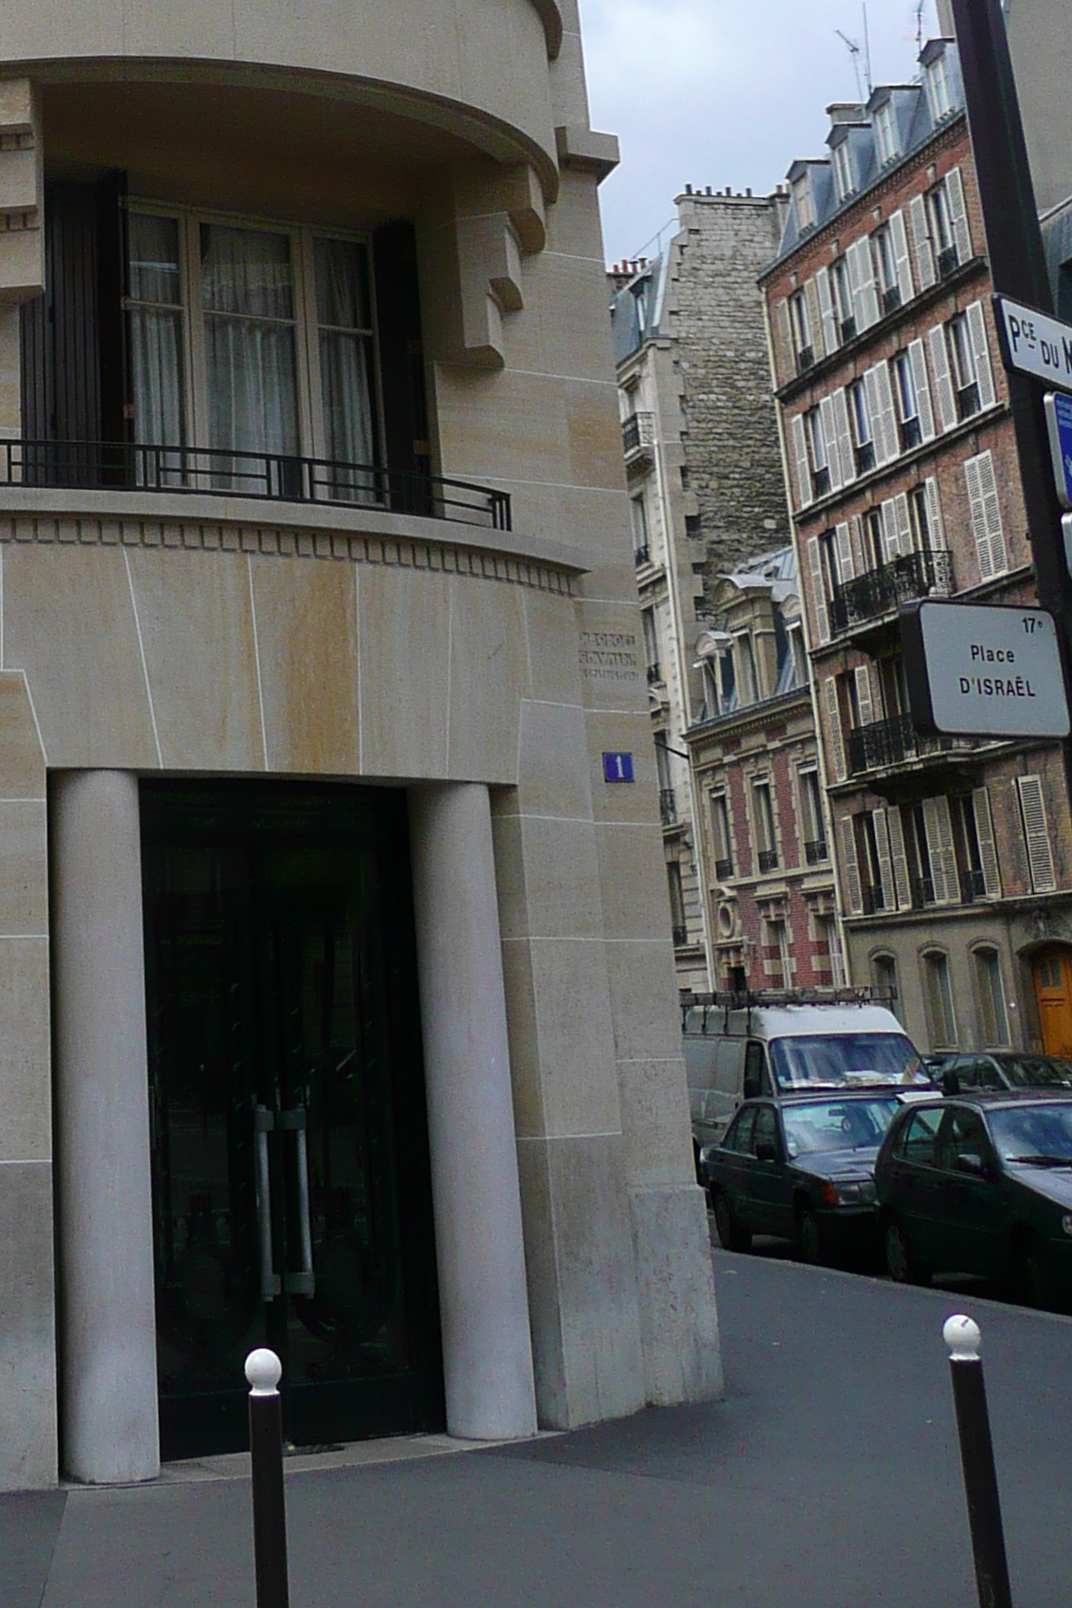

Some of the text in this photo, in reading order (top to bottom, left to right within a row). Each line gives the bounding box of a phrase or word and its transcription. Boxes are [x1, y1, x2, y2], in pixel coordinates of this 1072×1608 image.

[1040, 340, 1059, 369] DU
[970, 644, 1015, 663] Place
[959, 676, 1036, 697] D'ISRAËL
[615, 755, 625, 778] 1
